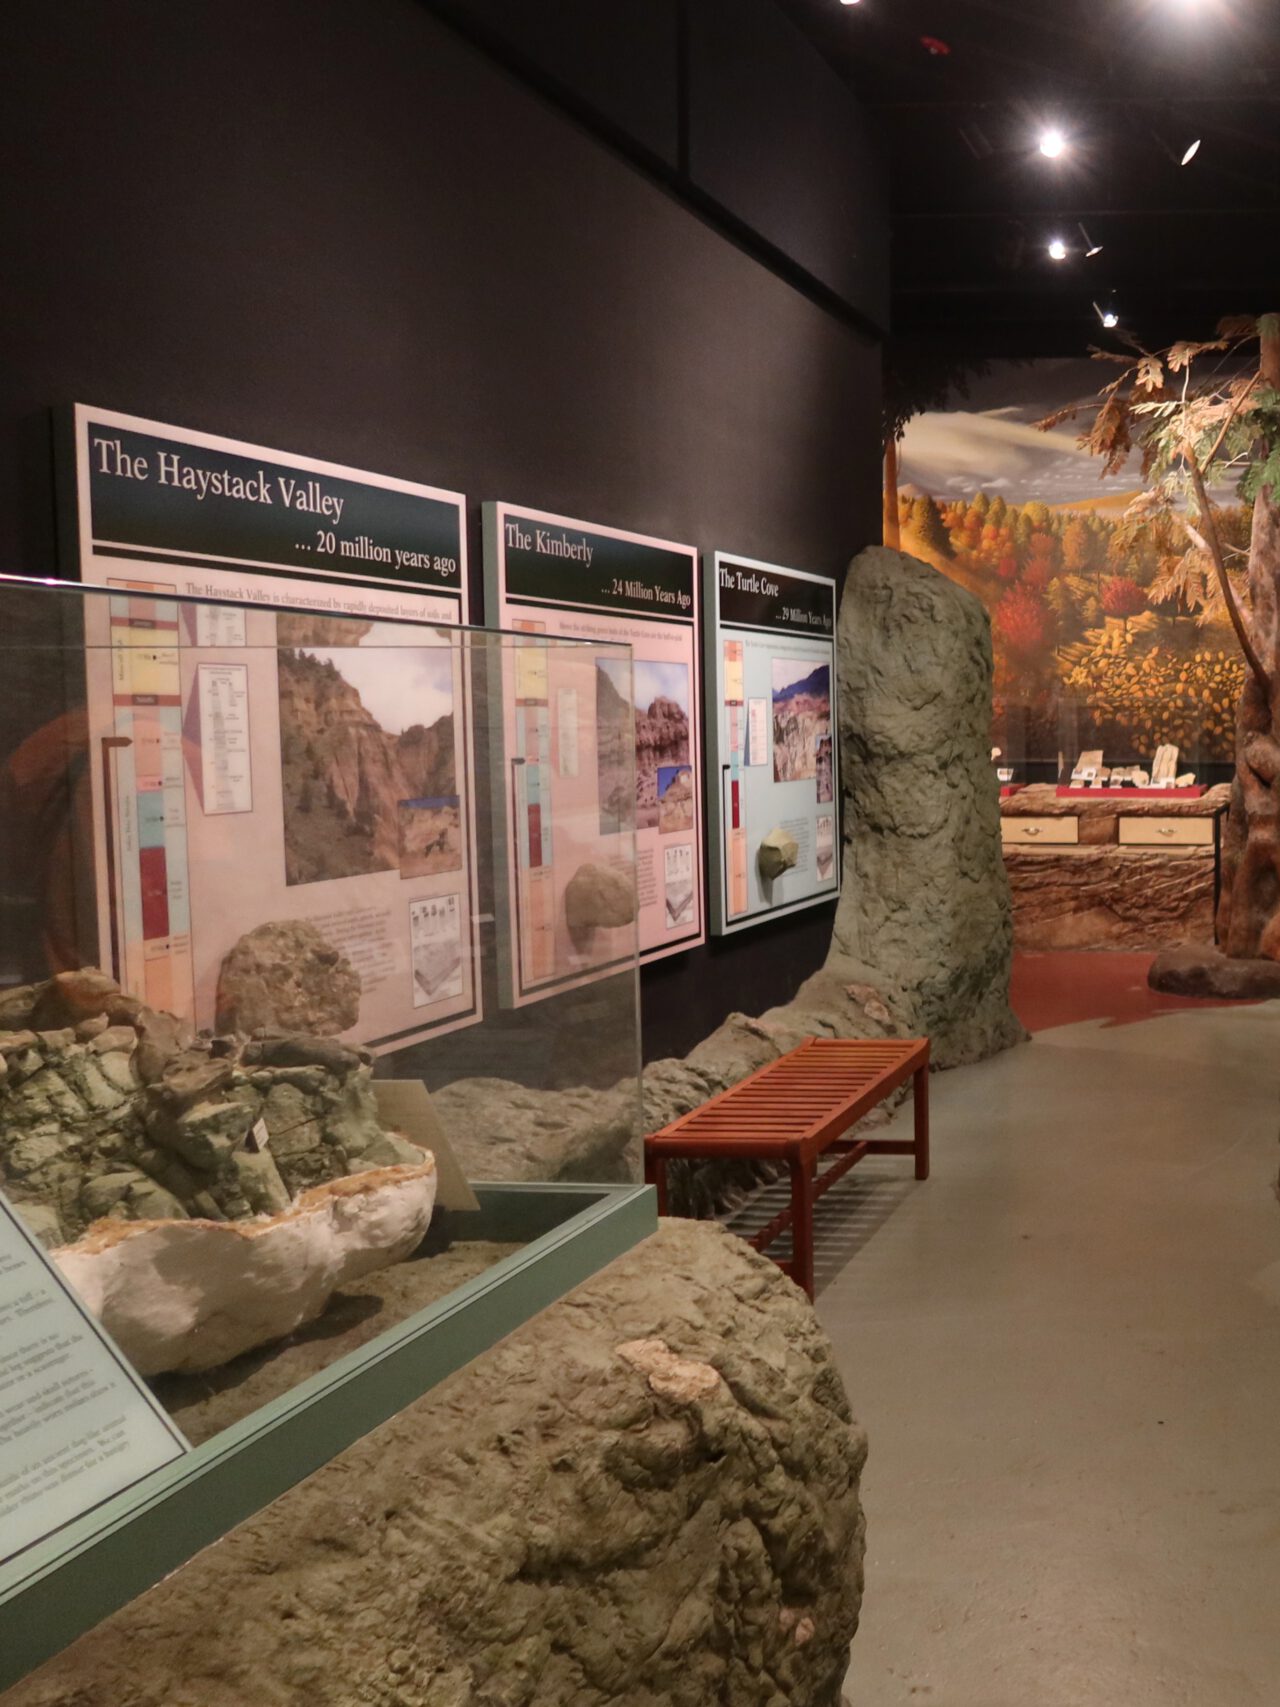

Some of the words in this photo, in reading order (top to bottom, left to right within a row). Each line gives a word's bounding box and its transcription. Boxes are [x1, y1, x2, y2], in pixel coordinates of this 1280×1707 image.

[94, 438, 149, 481] The
[157, 451, 272, 504] Haystack
[278, 477, 344, 525] Valley
[316, 530, 336, 553] 20
[340, 536, 391, 563] million
[395, 549, 430, 570] years
[433, 556, 456, 577] ago
[506, 523, 532, 550] The
[536, 529, 593, 568] Kimberly
[186, 582, 202, 595] The
[205, 584, 244, 599] Haystack
[612, 578, 623, 595] 24
[625, 580, 653, 601] Million
[654, 585, 675, 604] Years
[677, 589, 691, 609] Ago
[720, 568, 735, 589] The
[736, 572, 760, 594] Turtle
[761, 577, 779, 597] Cove
[782, 607, 789, 620] 29
[790, 608, 808, 624] Million
[808, 611, 822, 625] Years
